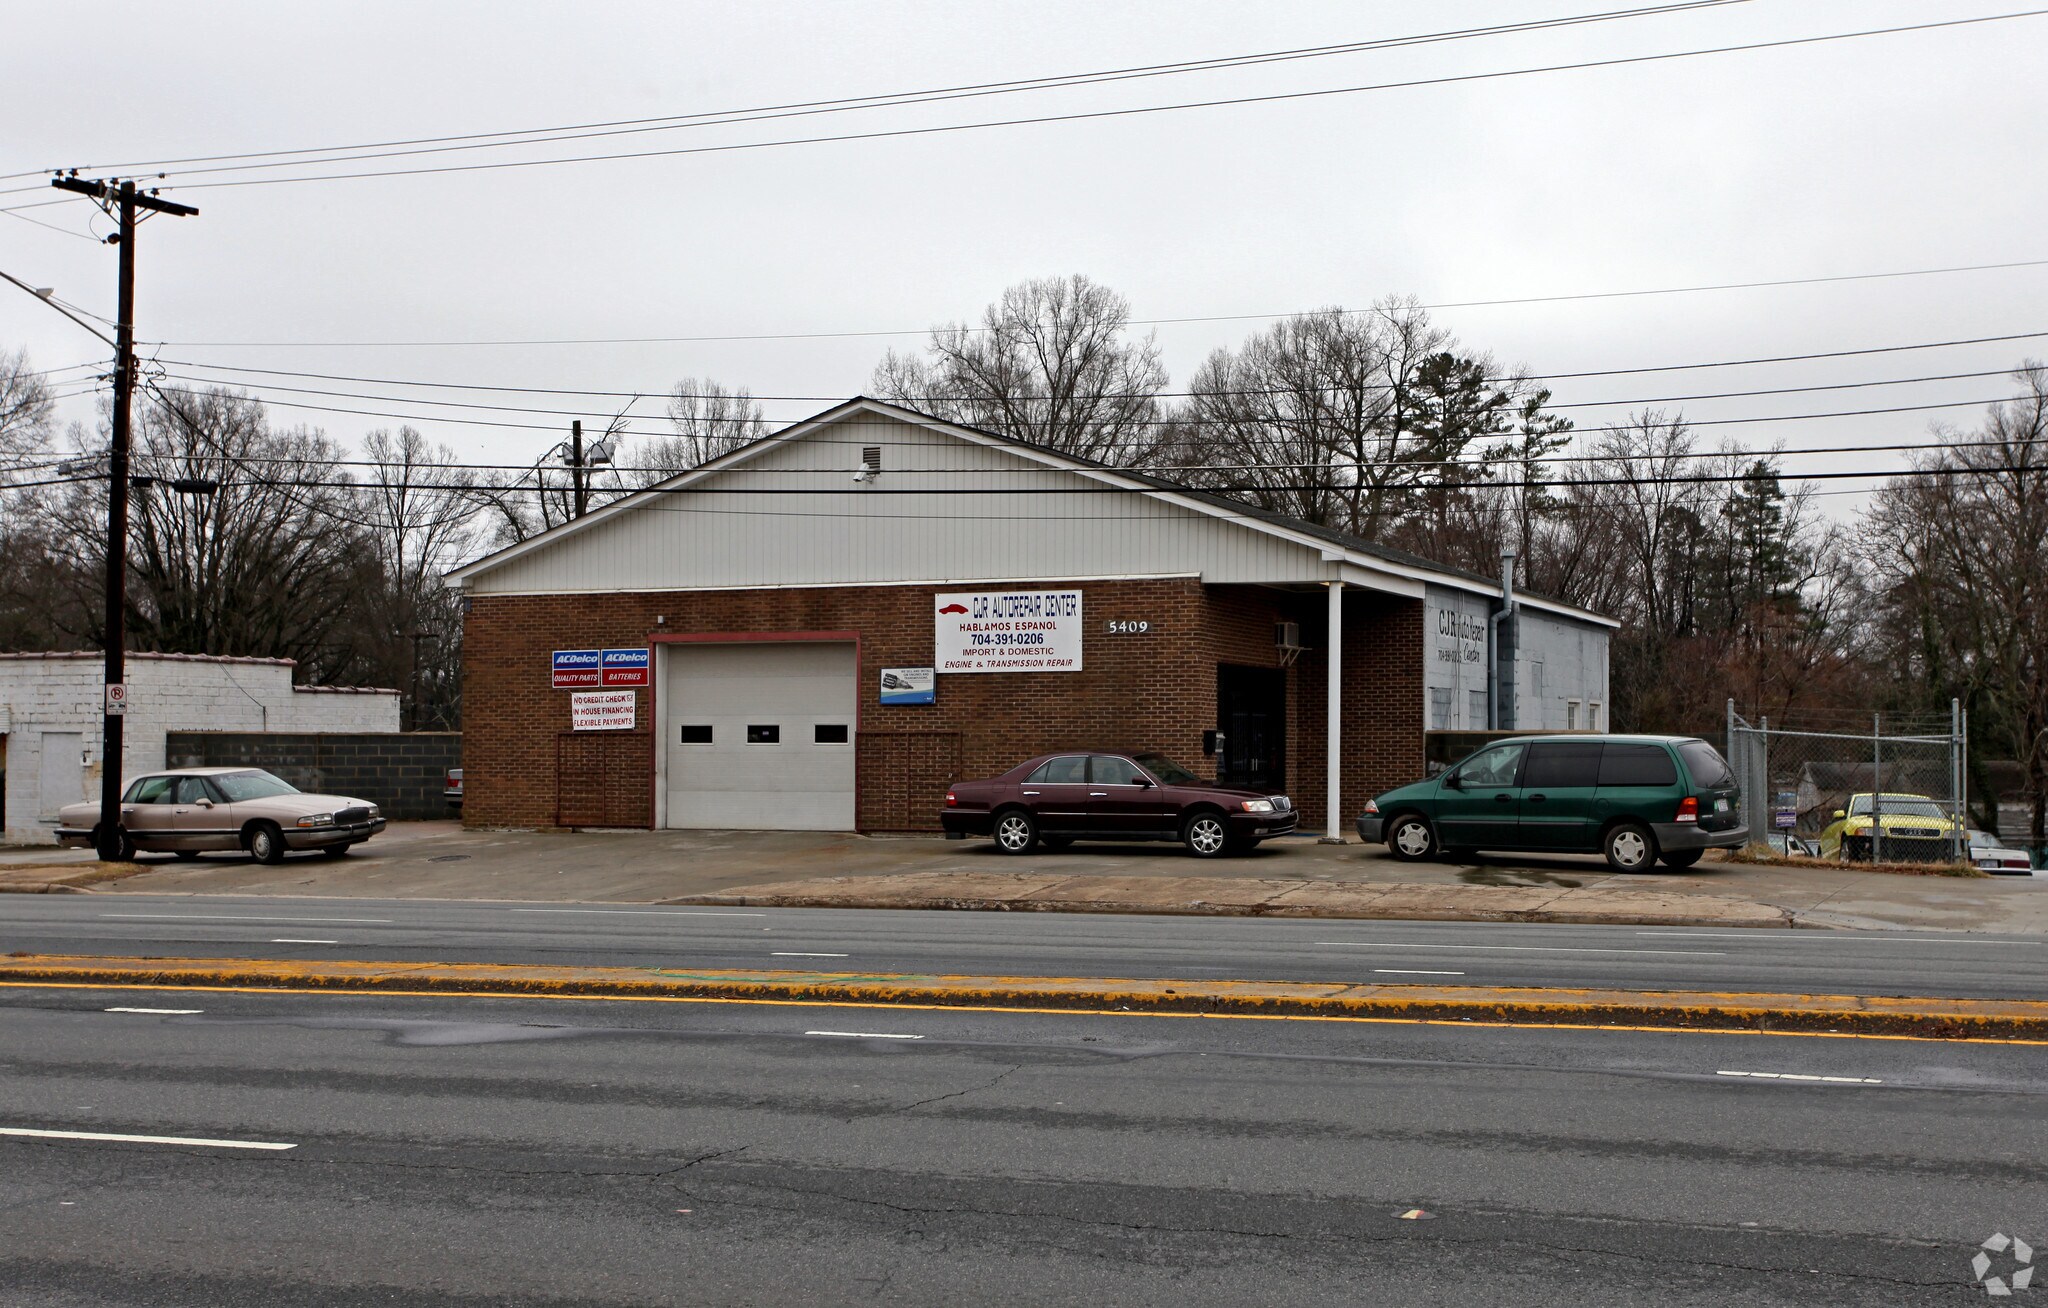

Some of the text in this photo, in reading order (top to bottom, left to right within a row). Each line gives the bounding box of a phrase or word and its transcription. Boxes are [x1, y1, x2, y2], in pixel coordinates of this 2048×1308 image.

[973, 594, 1077, 619] CJR AUTOREPAIR CENTER
[959, 621, 1057, 632] HABLAMOS ESPANOL
[1109, 621, 1148, 633] 5409
[1439, 609, 1456, 638] CJR
[971, 633, 1044, 645] 704-391-0206
[962, 648, 996, 656] IMPORT
[1008, 647, 1054, 655] DOMESTIC
[556, 654, 598, 664] ACDelco
[605, 653, 648, 663] ACDelco
[944, 661, 973, 669] ENGINE
[986, 659, 1044, 668] TRANSMISSION
[1046, 658, 1073, 667] REPAIR
[554, 674, 598, 683] QUALITY PARTS
[608, 673, 641, 681] BATTERIES
[573, 694, 626, 705] NO CREDIT CHECK
[573, 705, 634, 716] IN HOUSE FINANCING
[573, 717, 633, 727] FLEXIBLE PAYMENTS
